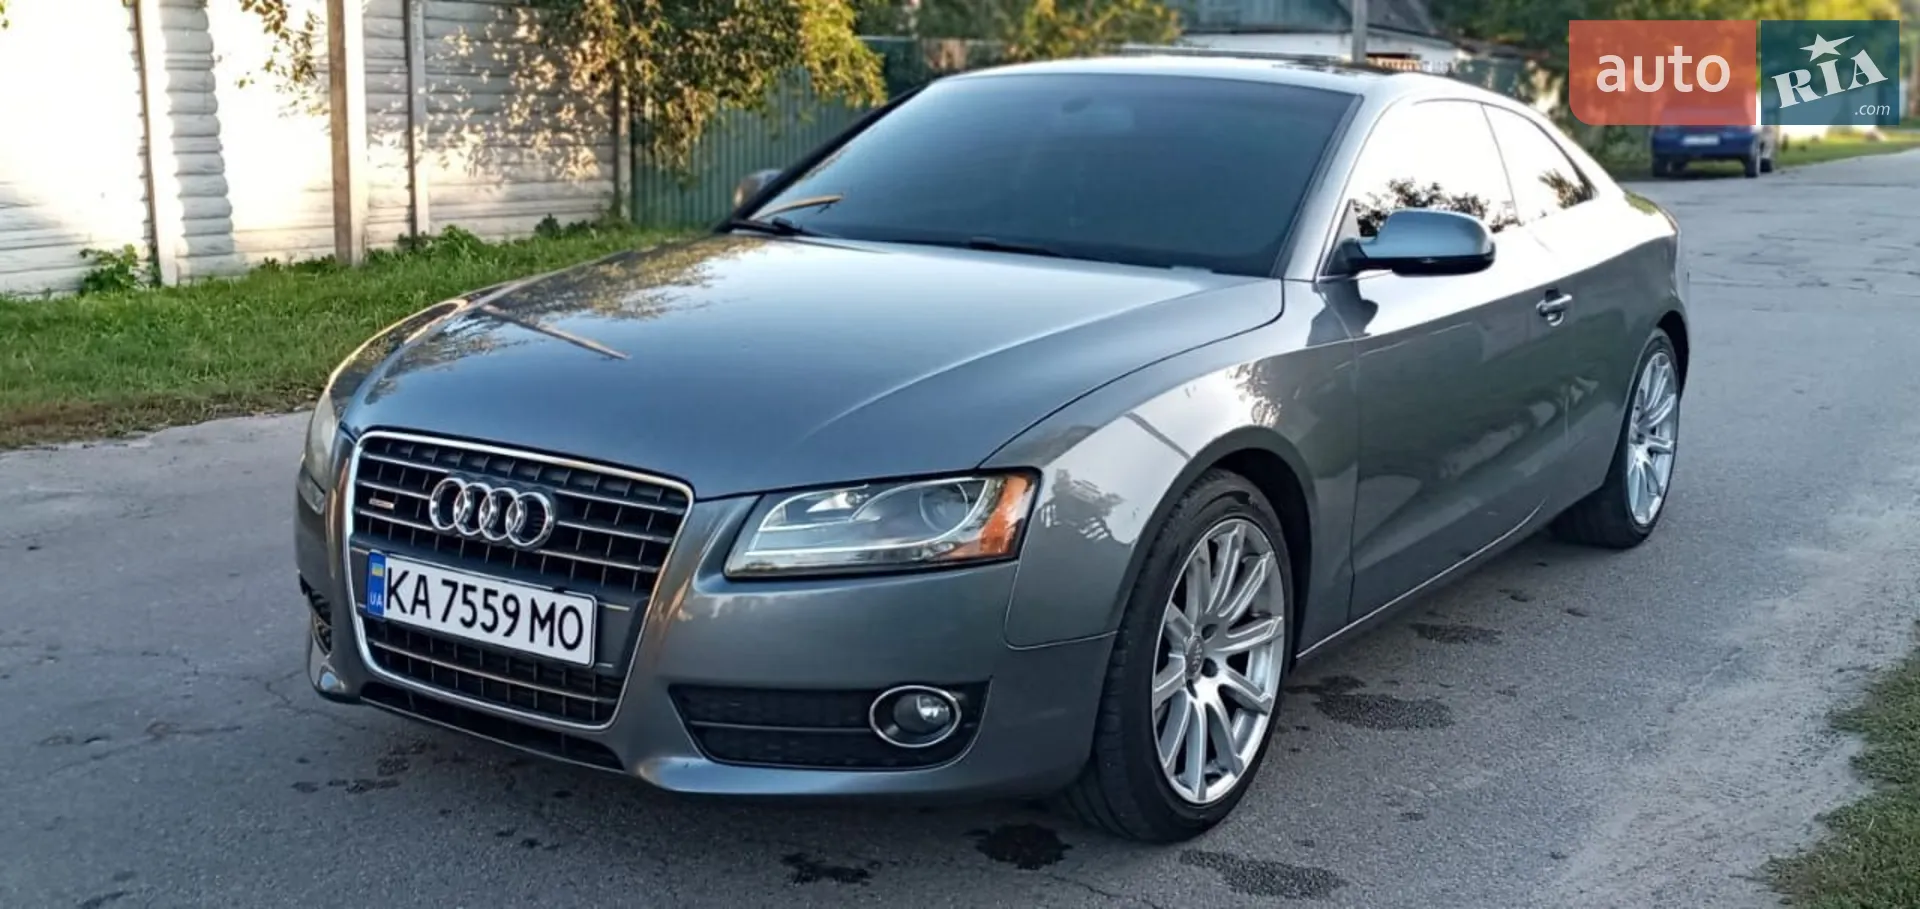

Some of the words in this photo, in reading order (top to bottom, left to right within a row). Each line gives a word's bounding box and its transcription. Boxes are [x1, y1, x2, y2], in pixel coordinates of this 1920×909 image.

[369, 591, 383, 607] UA
[386, 567, 431, 620] KA
[441, 579, 520, 637] 7559
[529, 598, 584, 651] MO
